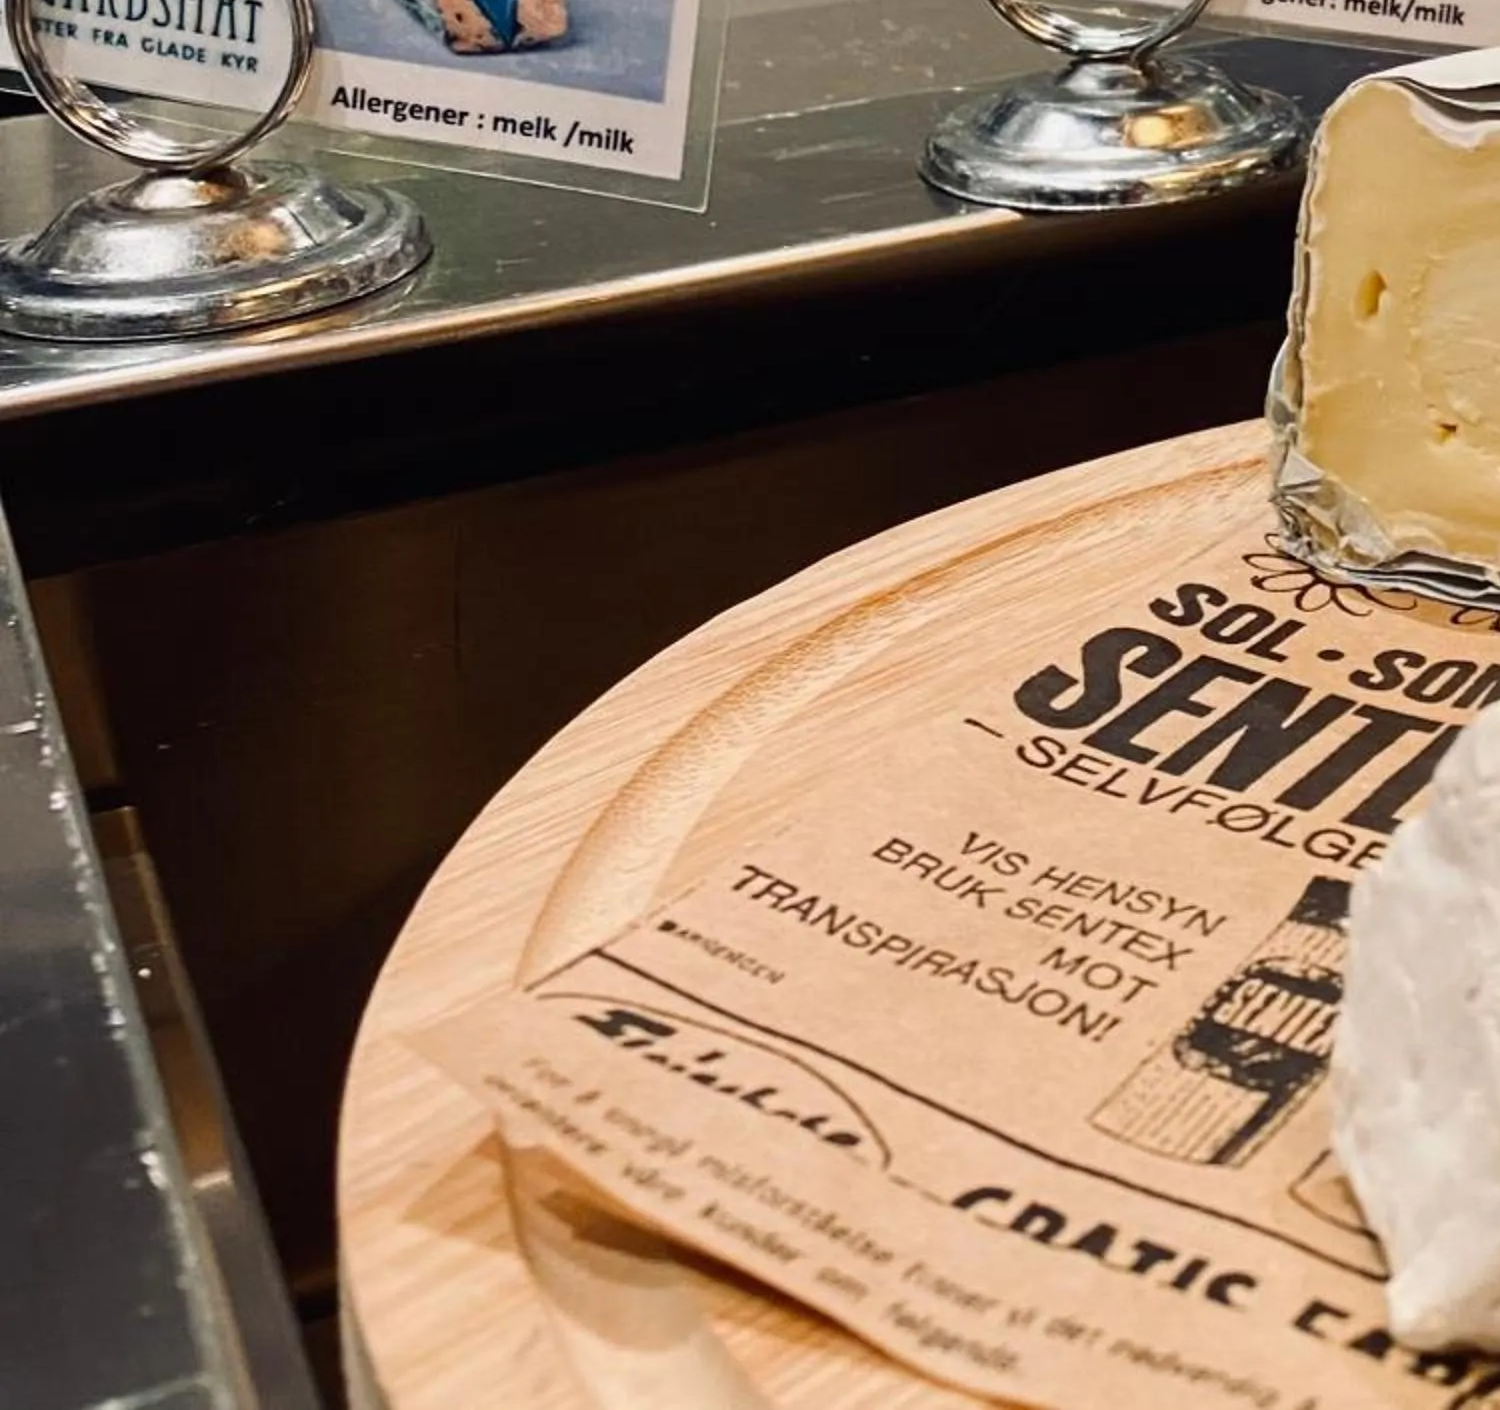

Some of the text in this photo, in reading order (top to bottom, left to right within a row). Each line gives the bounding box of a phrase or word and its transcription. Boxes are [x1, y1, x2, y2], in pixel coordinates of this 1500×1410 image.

[32, 16, 259, 74] STER FRA GLADE KYR
[330, 85, 470, 128] Allergener
[491, 114, 558, 142] melk
[1148, 582, 1306, 663] SOL
[871, 836, 1196, 973] BRUK SENTEX
[959, 830, 1230, 939] VIS HENSYN
[729, 863, 1125, 1044] TRANSPIRASJON!
[1037, 945, 1162, 1005] MOT
